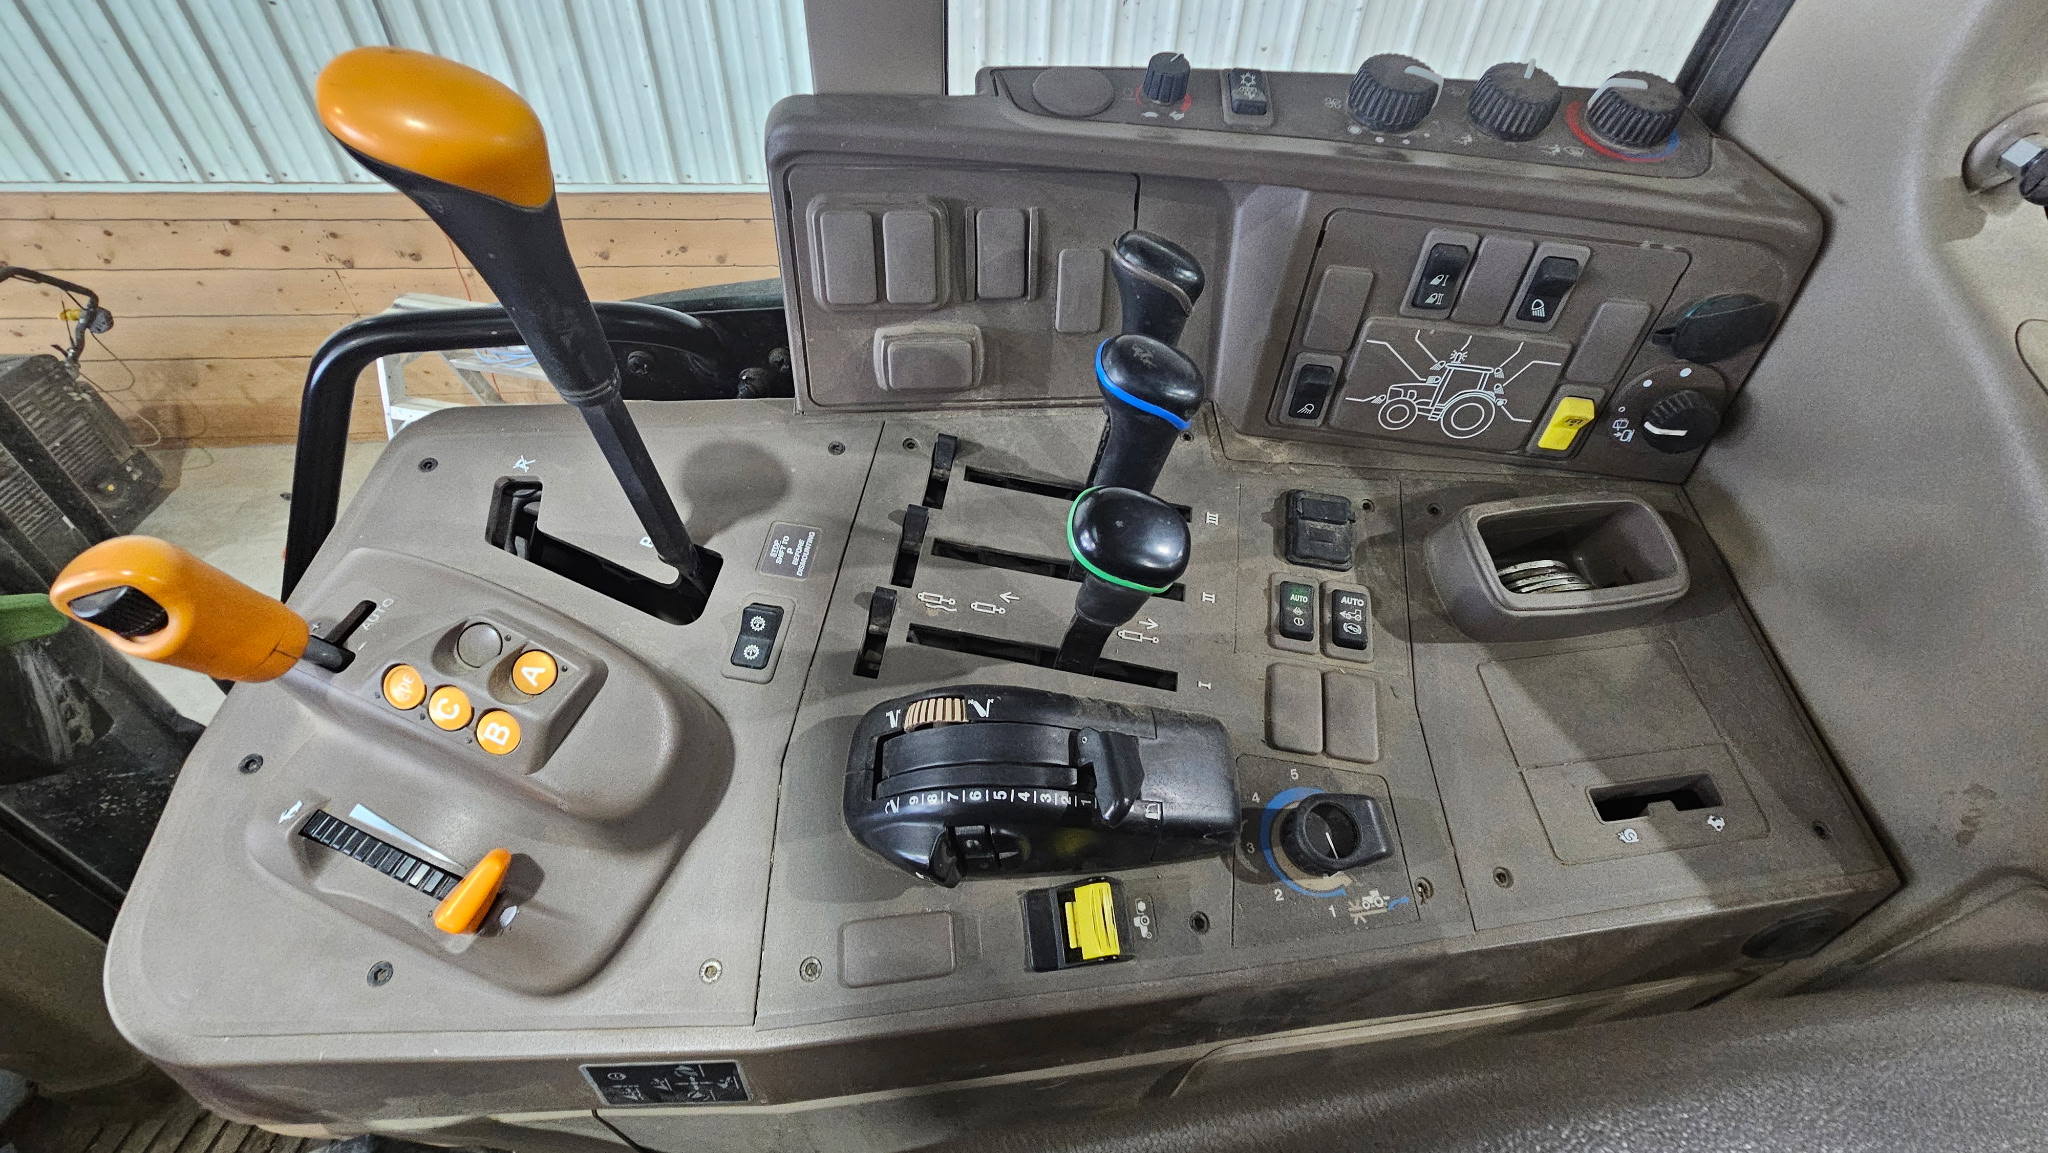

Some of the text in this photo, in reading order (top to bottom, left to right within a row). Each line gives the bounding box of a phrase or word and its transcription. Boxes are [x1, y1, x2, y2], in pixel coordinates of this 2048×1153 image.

[770, 539, 780, 558] STOP
[775, 535, 790, 565] SHIFT TO
[786, 547, 794, 555] P
[791, 538, 805, 566] BEFORE
[796, 531, 816, 577] DISMOUNTING
[1289, 593, 1309, 604] AUTO
[1340, 596, 1365, 607] AUTO
[361, 598, 395, 632] AUTO
[521, 666, 546, 687] A
[436, 698, 461, 720] C
[483, 722, 511, 747] B
[1290, 768, 1299, 780] 5
[908, 790, 1092, 806] 9 8 7 6 5 4 3 2 1
[1252, 792, 1260, 804] 4
[1246, 842, 1255, 854] 3
[1273, 888, 1284, 902] 2
[1328, 904, 1337, 918] 1
